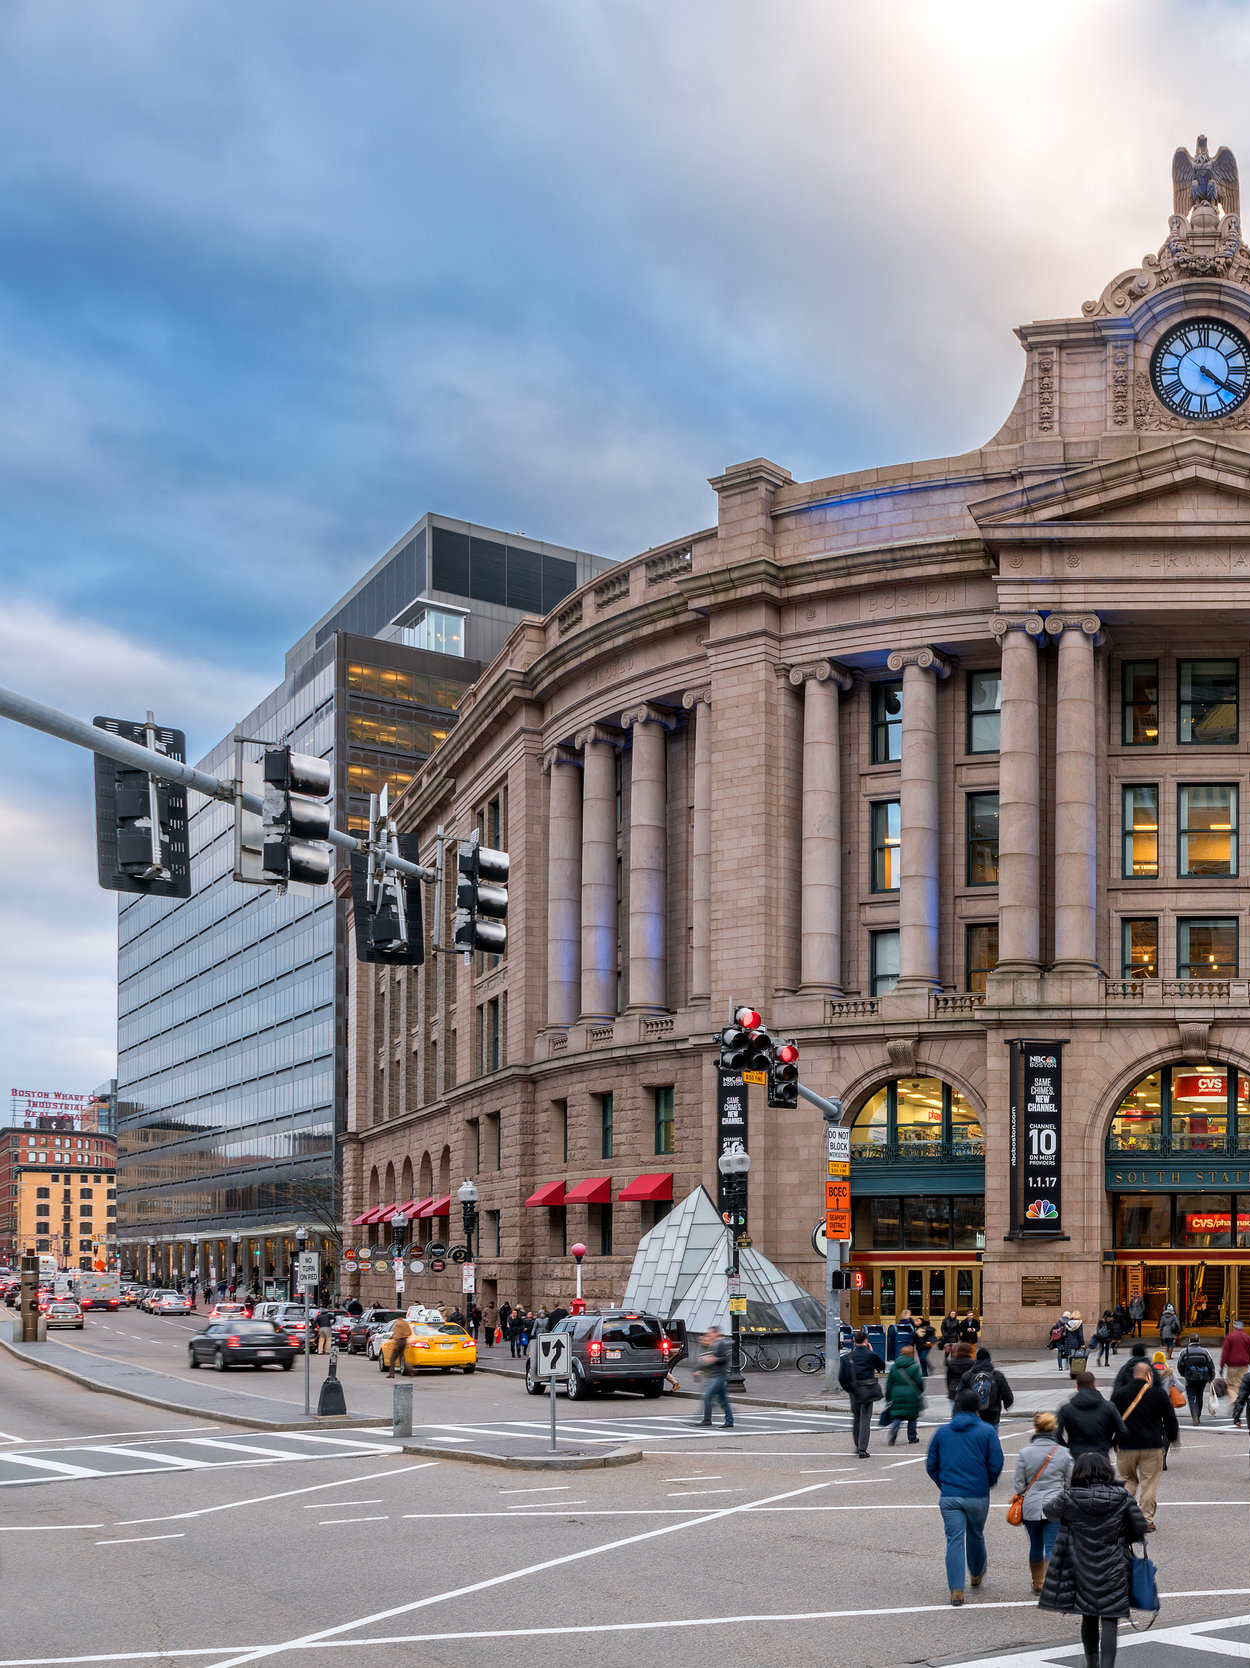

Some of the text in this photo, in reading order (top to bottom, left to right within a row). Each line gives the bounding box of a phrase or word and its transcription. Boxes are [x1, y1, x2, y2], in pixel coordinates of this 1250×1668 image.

[1180, 334, 1193, 351] XI
[1198, 330, 1209, 346] XII
[1216, 334, 1225, 350] I
[1166, 345, 1181, 360] X
[1225, 347, 1241, 360] II
[1161, 367, 1178, 375] IX
[1229, 366, 1246, 375] III
[1164, 380, 1184, 398] VIII
[1178, 392, 1193, 409] VII
[1200, 396, 1208, 413] VI
[1216, 392, 1227, 408] V
[869, 587, 956, 612] BOSTON
[586, 656, 633, 690] ERECTED
[1034, 1077, 1051, 1086] SAME
[1198, 1078, 1222, 1088] CVS
[11, 1088, 49, 1099] BOSTON
[53, 1091, 84, 1101] WHARF
[1031, 1086, 1054, 1095] CHIMES.
[28, 1100, 85, 1111] INDUSTRIAL
[1035, 1095, 1050, 1103] NEW
[1027, 1103, 1057, 1112] CHANNEL.
[25, 1109, 90, 1121] REAL ESTATE
[829, 1131, 849, 1139] DO NOT
[1029, 1129, 1056, 1154] 10
[830, 1142, 847, 1150] BLOCK
[1028, 1177, 1057, 1187] 1.1.17
[1115, 1171, 1181, 1184] SOUTH
[828, 1186, 847, 1197] BCEC
[456, 1253, 465, 1262] 2
[855, 1272, 862, 1287] 9
